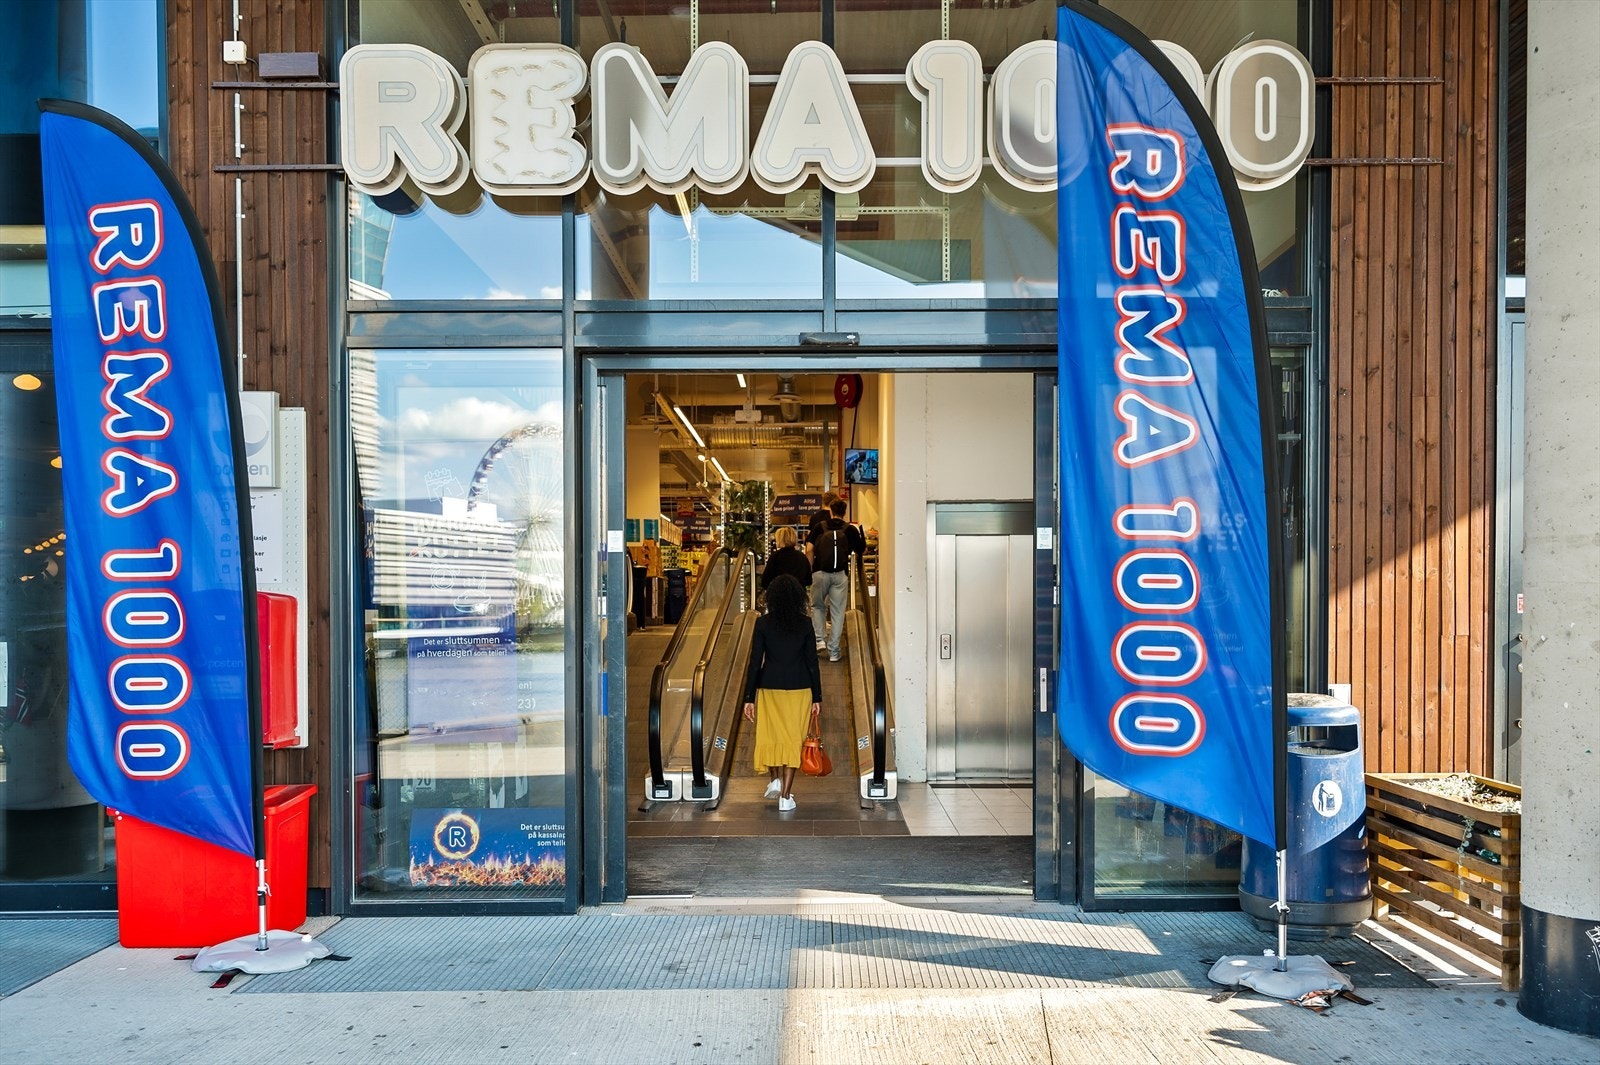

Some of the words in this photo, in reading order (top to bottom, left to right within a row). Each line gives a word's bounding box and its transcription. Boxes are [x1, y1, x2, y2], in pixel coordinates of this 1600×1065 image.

[339, 41, 877, 197] REMA
[1104, 120, 1201, 470] REMA
[86, 198, 180, 519] REMA
[100, 538, 194, 782] 1000
[416, 650, 426, 658] på
[426, 648, 473, 658] hverdagen
[444, 636, 500, 645] sluttsummen
[1109, 494, 1209, 758] 1000
[449, 826, 466, 847] R
[520, 823, 533, 831] Det
[528, 831, 537, 839] på
